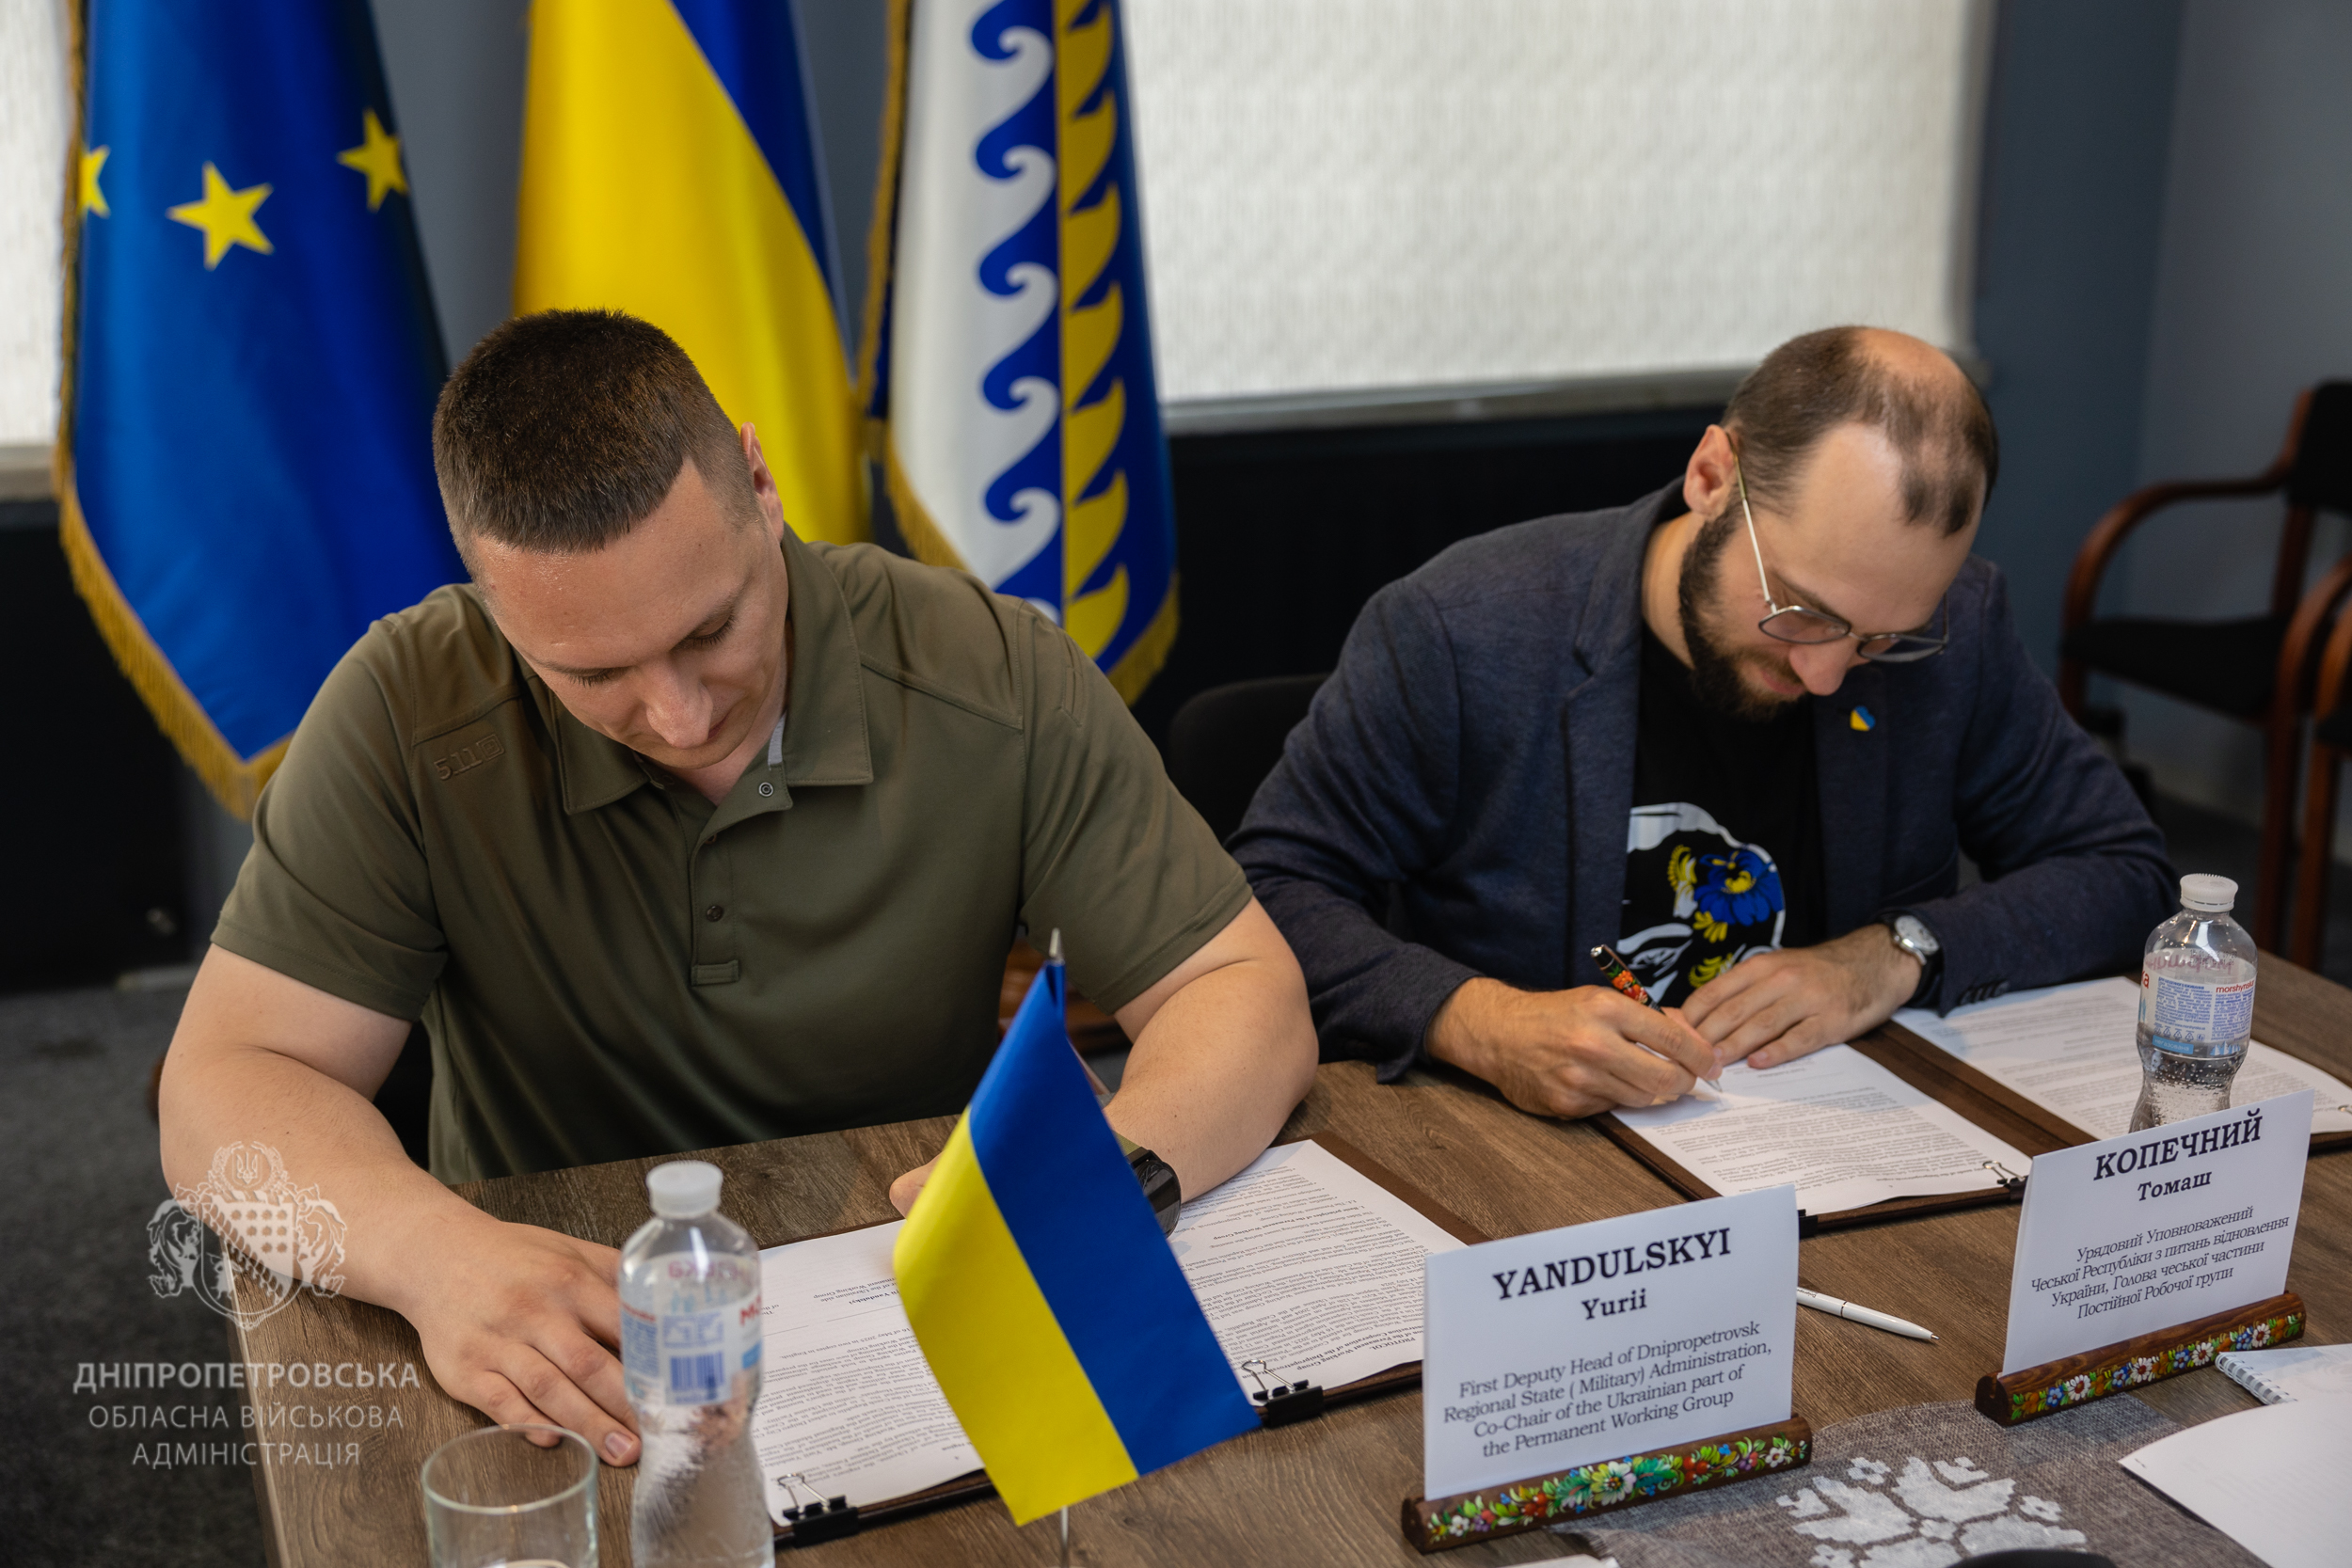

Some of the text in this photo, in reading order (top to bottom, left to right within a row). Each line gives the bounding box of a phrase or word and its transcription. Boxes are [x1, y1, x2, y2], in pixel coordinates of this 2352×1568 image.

[434, 747, 483, 781] 5.11
[2092, 1107, 2264, 1181] КОПЕЧНИЙ
[2137, 1171, 2213, 1202] Томаш
[1312, 1209, 1343, 1217] principles
[1262, 1219, 1295, 1228] Permanent
[1233, 1227, 1262, 1235] Working
[2076, 1205, 2254, 1264] Урядовий Уповноважений
[2031, 1216, 2290, 1292] Чеської Республіки з питань відновлення
[1491, 1227, 1732, 1302] YANDULSKYI
[2051, 1241, 2265, 1307] України, Голова чеської частини
[834, 1284, 866, 1293] Working
[835, 1289, 869, 1298] Ukrainian
[2076, 1267, 2234, 1320] Постійної Робочої групи
[849, 1292, 890, 1305] Yandulskyi
[1580, 1287, 1648, 1322] Yurii
[1294, 1315, 1319, 1326] between
[1315, 1312, 1354, 1323] Cooperation
[1234, 1322, 1268, 1334] Agreement
[1249, 1325, 1279, 1336] industrial
[1296, 1323, 1314, 1332] signed
[1318, 1329, 1343, 1340] referred
[1246, 1328, 1284, 1342] Government
[1264, 1333, 1286, 1341] Prague
[1271, 1324, 1327, 1346] Intergovernmental
[1343, 1332, 1388, 1347] Cooperation
[867, 1338, 898, 1348] Working
[1231, 1344, 1269, 1355] Commission
[1289, 1341, 1330, 1356] Coordination
[1353, 1337, 1392, 1351] Permanent
[1369, 1337, 1416, 1351] PROTOCOL
[1249, 1345, 1282, 1356] accordance
[1320, 1348, 1354, 1361] Working
[1295, 1361, 1322, 1370] Group
[1459, 1320, 1761, 1399] First Deputy Head of Dnipropetrovsk
[1443, 1393, 1517, 1424] Regional
[1520, 1379, 1565, 1406] State
[1579, 1366, 1645, 1395] Military)
[1649, 1342, 1772, 1379] Administration,
[1473, 1363, 1746, 1438] Co-Chair of the Ukrainian part of
[1483, 1391, 1734, 1458] the Permanent Working Group
